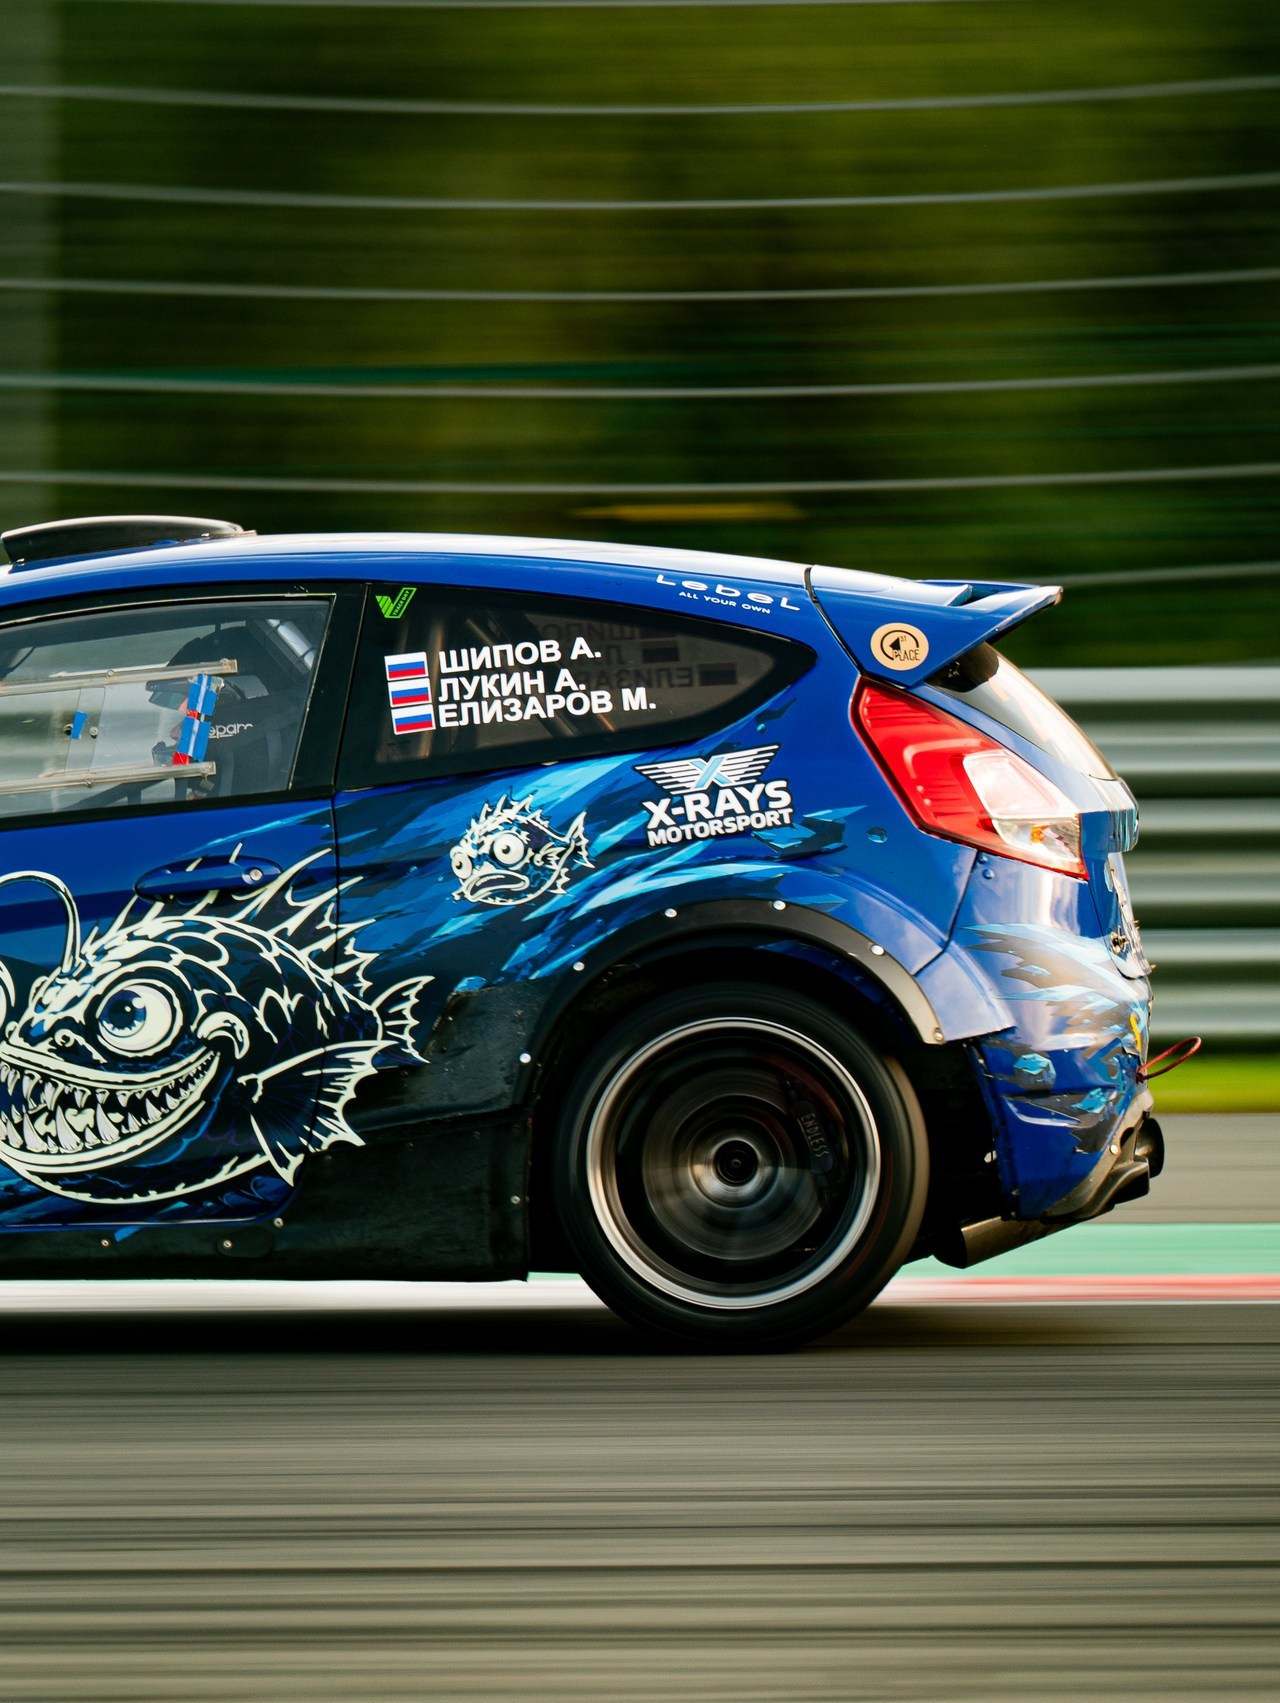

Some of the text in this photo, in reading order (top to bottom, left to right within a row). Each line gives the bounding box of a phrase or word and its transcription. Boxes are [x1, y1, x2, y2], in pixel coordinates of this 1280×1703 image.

[393, 600, 405, 616] TRACK
[678, 591, 771, 614] ALL YOUR OWN
[438, 638, 562, 674] ШИПОВ
[570, 636, 602, 661] А.
[892, 649, 920, 661] PLACE
[437, 666, 586, 702] ЛУКИН А.
[438, 686, 657, 728] ЕЛИЗАРОВ М.
[642, 780, 792, 829] X-RAYS
[647, 808, 793, 847] MOTORSPORT
[800, 1112, 830, 1157] ENDLESS
